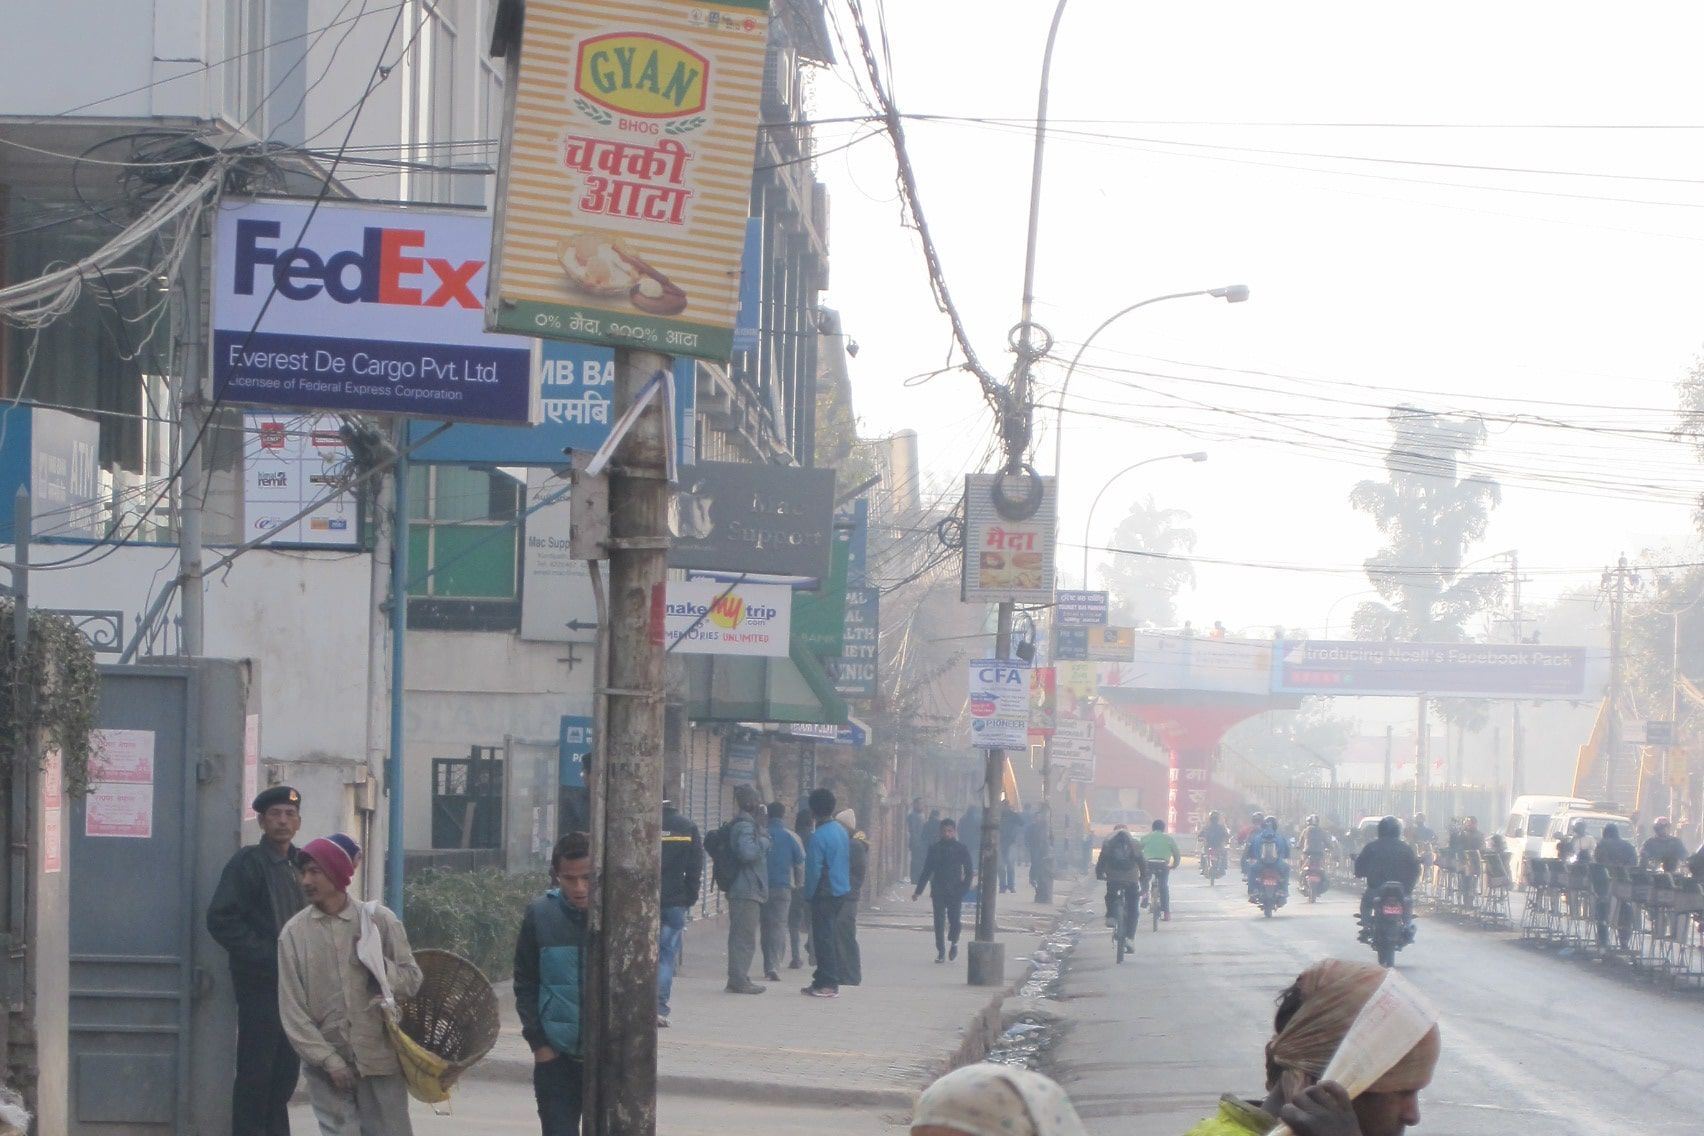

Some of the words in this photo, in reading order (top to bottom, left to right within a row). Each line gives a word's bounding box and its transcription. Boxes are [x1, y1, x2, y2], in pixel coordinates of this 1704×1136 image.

[590, 47, 698, 107] GYAN
[618, 118, 660, 135] BHOG
[563, 135, 694, 184] चक्की
[578, 175, 694, 225] आटा
[234, 219, 486, 309] FedEx
[665, 330, 699, 348] आटा
[229, 344, 309, 371] Everest
[315, 350, 346, 374] De
[352, 353, 415, 381] Cargo
[421, 357, 459, 381] Pvt.
[465, 360, 499, 383] Ltd.
[583, 360, 615, 386] BA
[284, 378, 296, 389] of
[299, 378, 342, 392] Federal
[345, 381, 391, 396] Express
[395, 384, 463, 400] Corporation
[541, 390, 611, 424] एमबि
[258, 477, 287, 487] remit
[528, 536, 546, 548] Mac
[548, 536, 571, 551] Supp
[986, 526, 1040, 552] मैदा
[746, 604, 777, 620] trip
[723, 633, 769, 643] UNLIMITED
[843, 627, 875, 640] LTH
[844, 645, 876, 658] IETY
[1306, 648, 1383, 664] troducing
[1448, 650, 1528, 665] Facebook
[1532, 652, 1573, 666] Pack
[979, 668, 1022, 684] CFA
